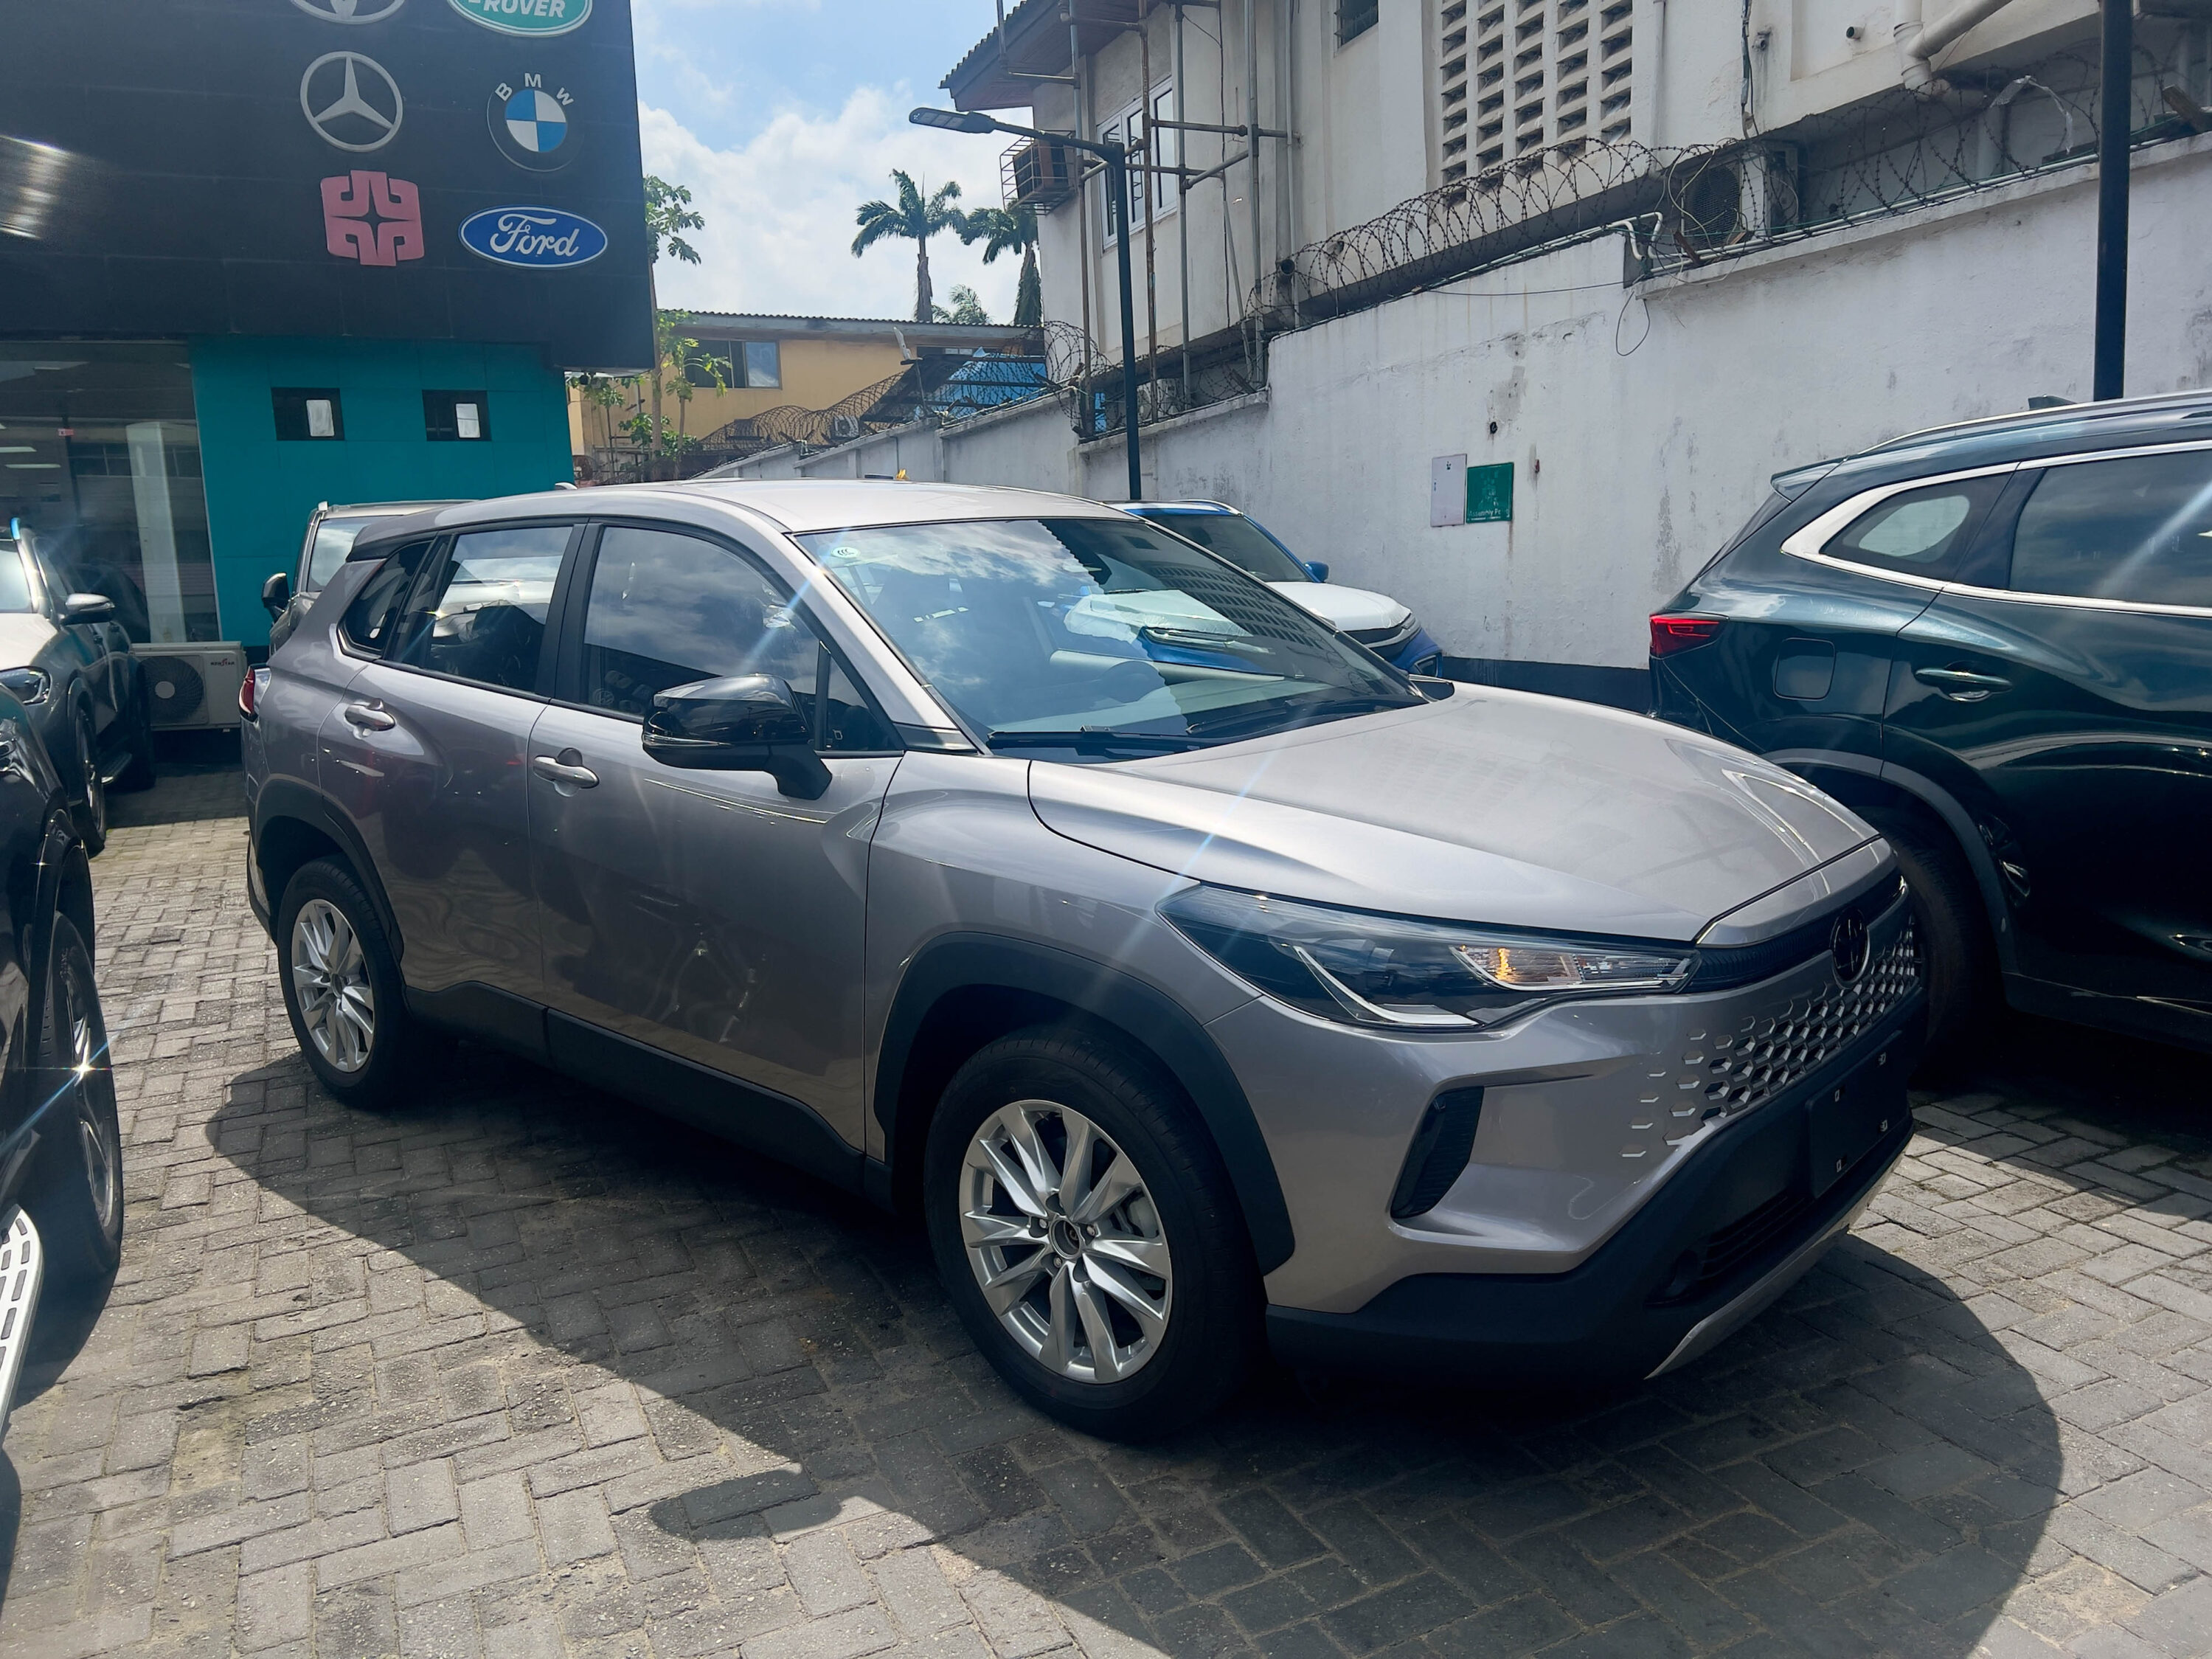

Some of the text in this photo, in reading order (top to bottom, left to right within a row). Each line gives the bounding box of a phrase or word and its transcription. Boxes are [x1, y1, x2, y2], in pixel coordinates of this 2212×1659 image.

[483, 0, 566, 18] ROVER
[495, 72, 574, 107] BMW
[489, 213, 580, 258] Ford
